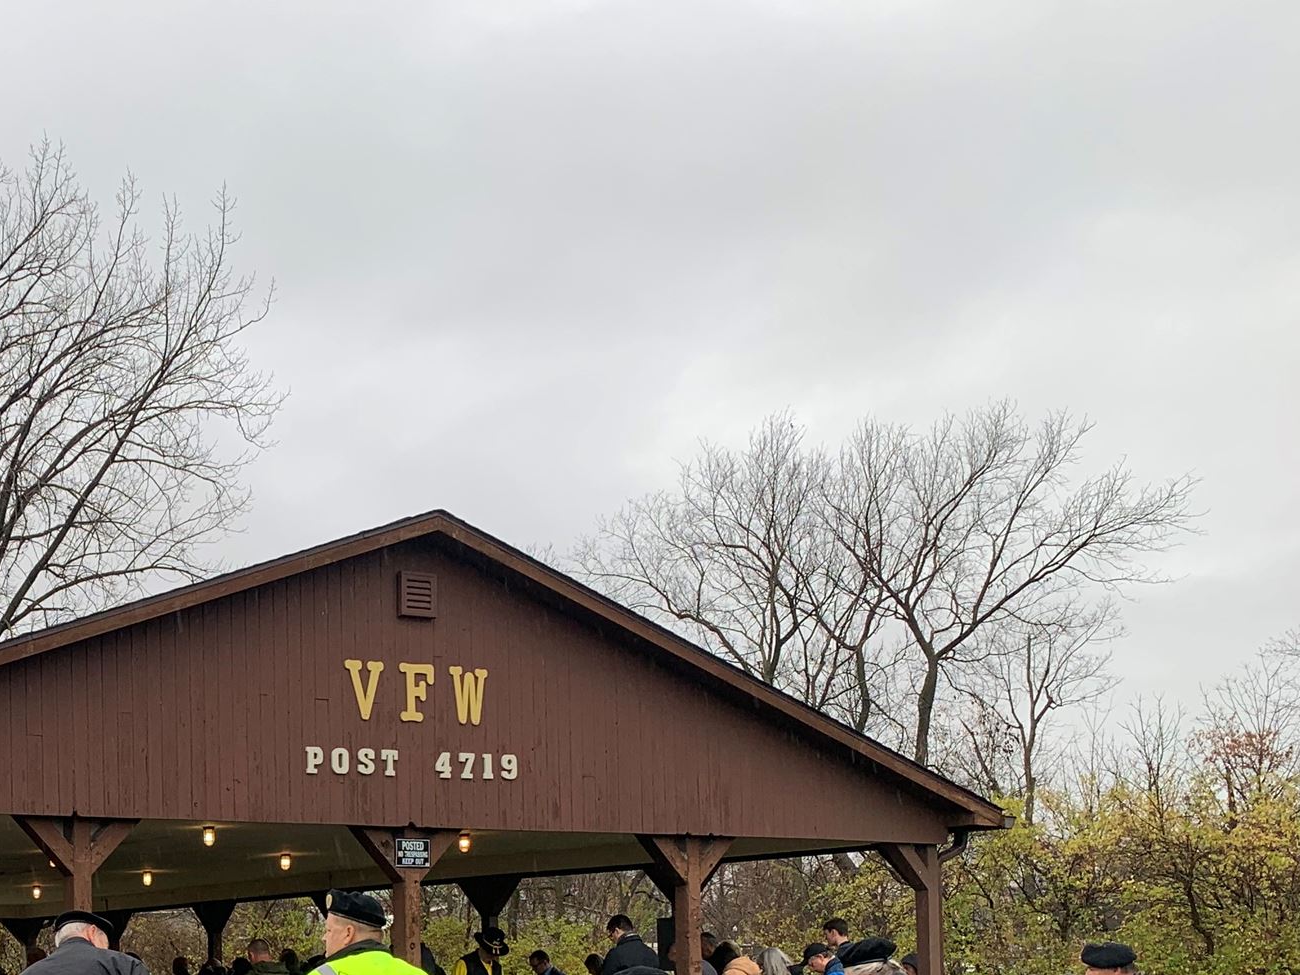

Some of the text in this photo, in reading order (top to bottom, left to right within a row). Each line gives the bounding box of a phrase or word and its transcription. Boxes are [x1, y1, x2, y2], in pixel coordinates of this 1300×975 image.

[305, 747, 518, 780] POST 4719
[402, 841, 424, 850] POSTED
